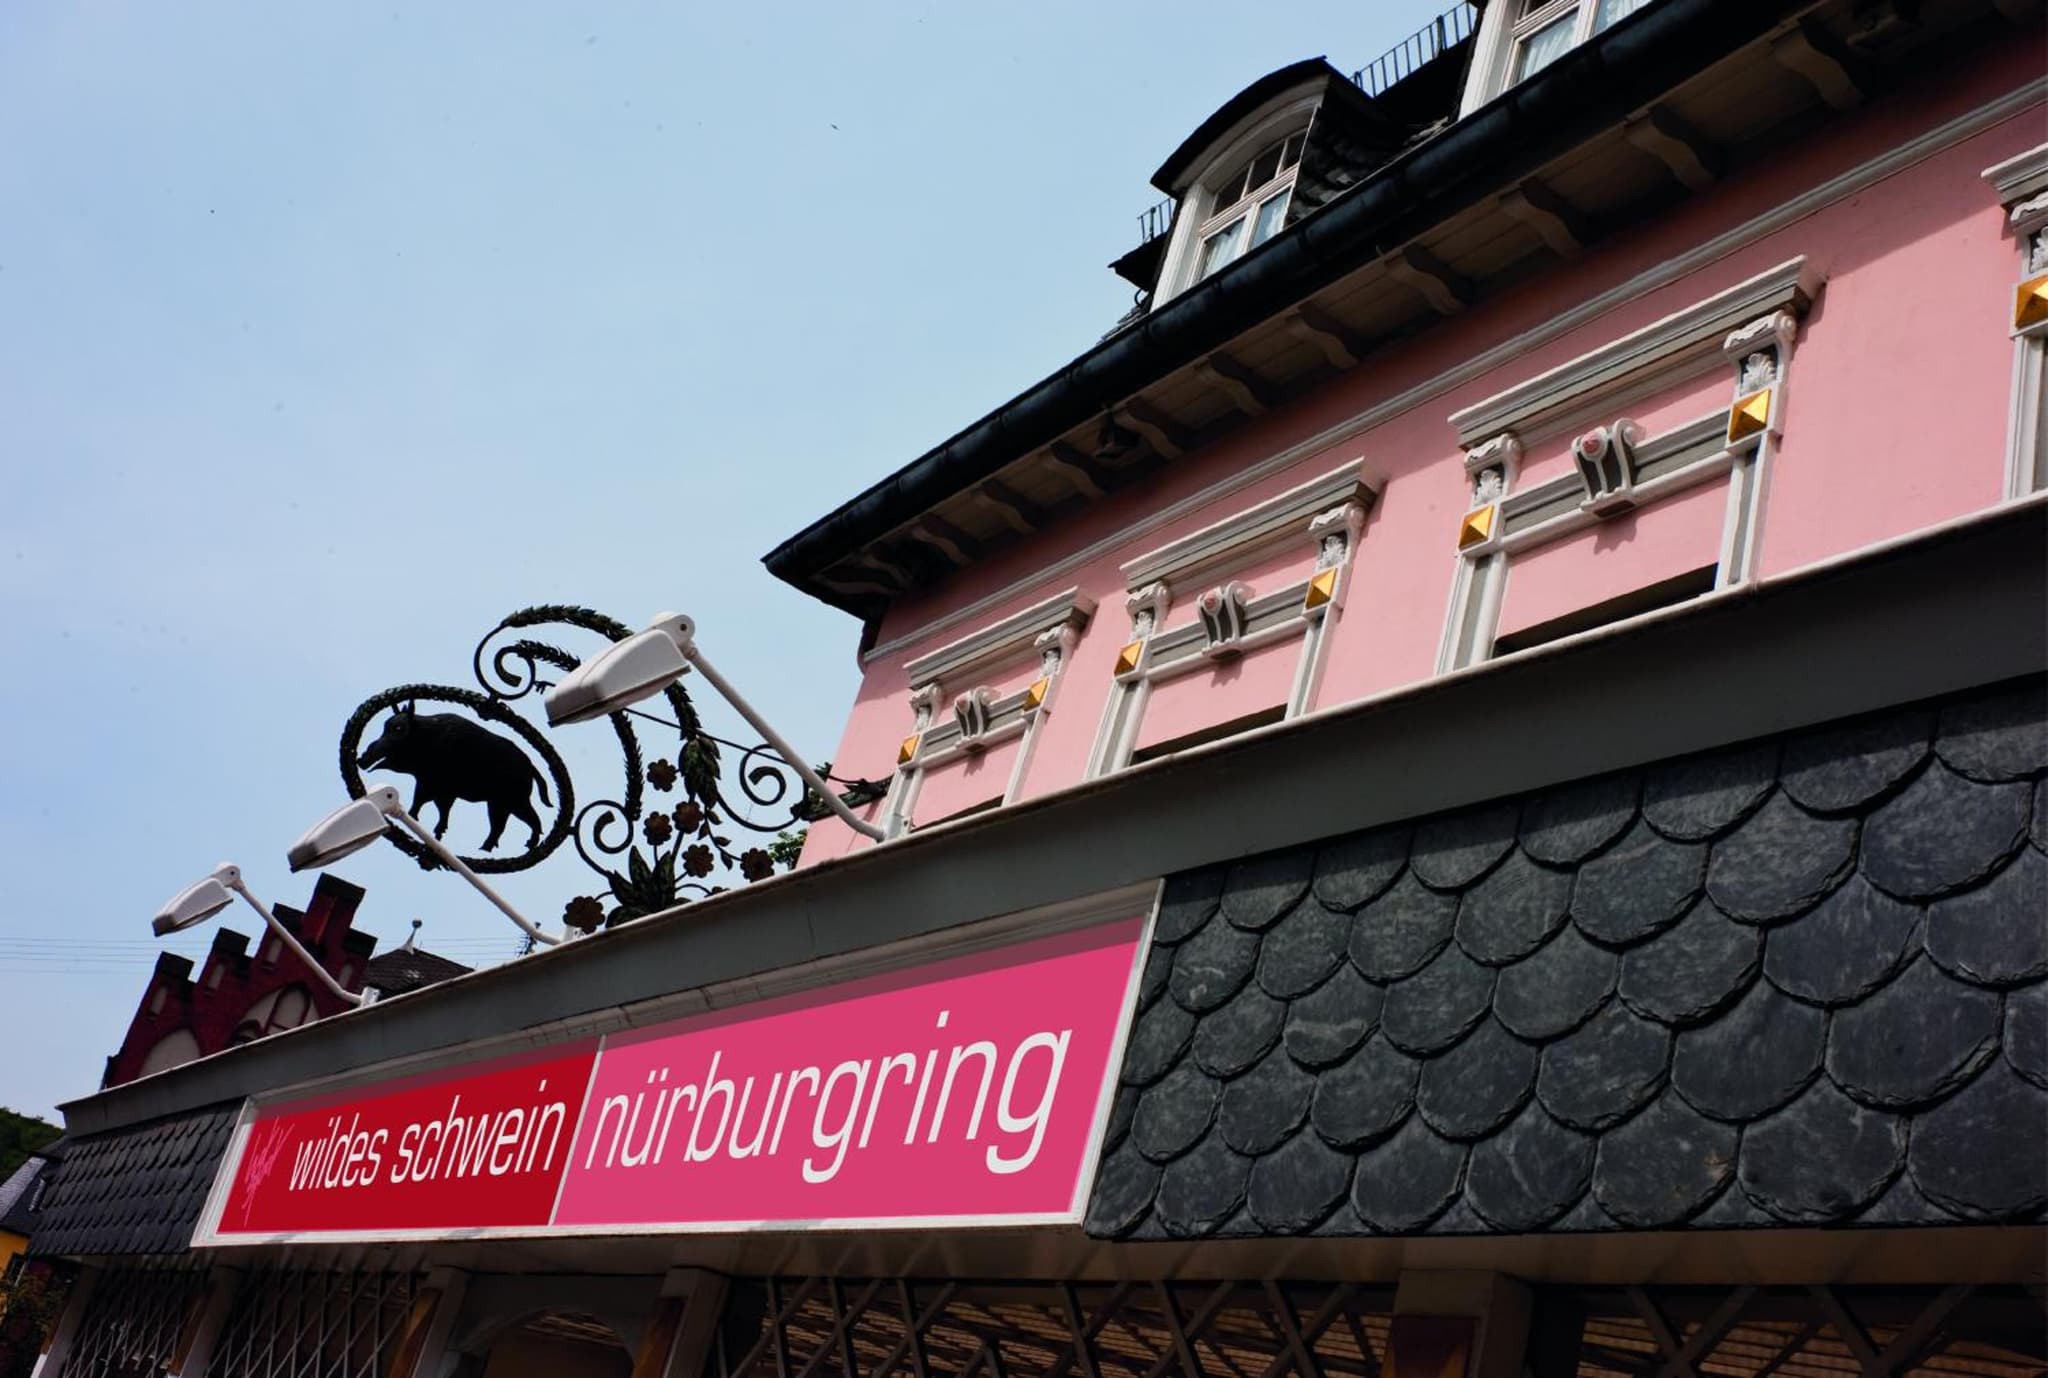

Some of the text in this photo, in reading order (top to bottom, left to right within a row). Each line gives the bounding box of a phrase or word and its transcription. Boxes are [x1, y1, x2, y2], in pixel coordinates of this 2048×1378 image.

[288, 1079, 567, 1192] wildes schwein
[584, 1010, 1073, 1184] nürburgring
